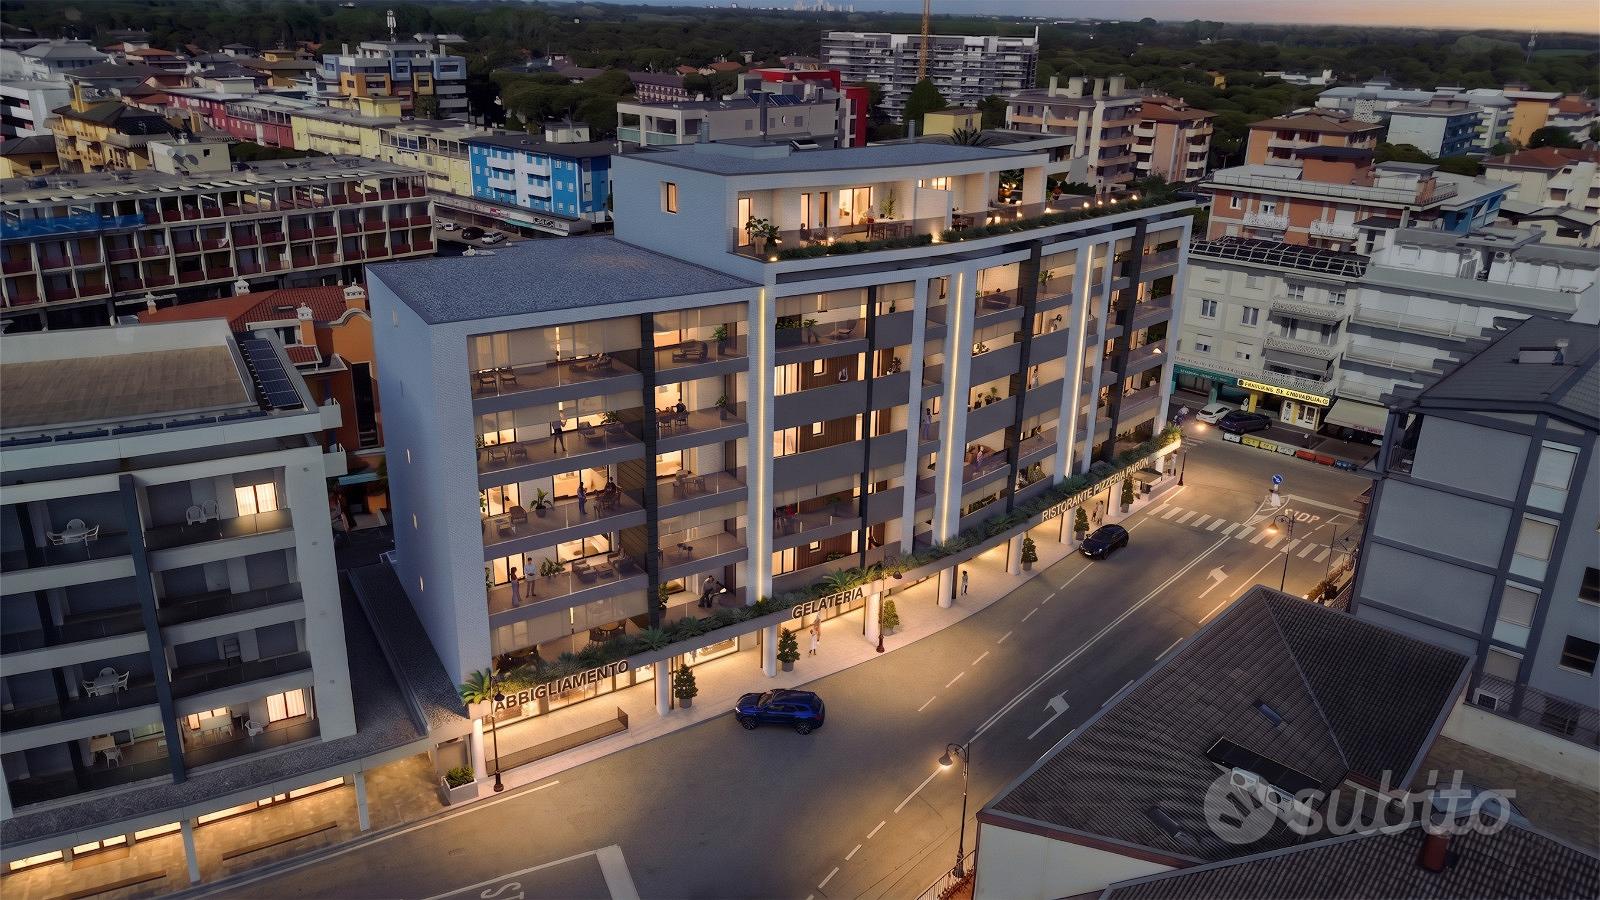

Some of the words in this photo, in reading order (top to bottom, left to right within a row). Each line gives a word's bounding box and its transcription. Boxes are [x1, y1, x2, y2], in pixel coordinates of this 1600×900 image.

[1042, 488, 1093, 521] RISTORANTE
[1093, 469, 1125, 496] PIZZERIA
[1125, 457, 1149, 477] PARON
[792, 587, 863, 619] GELATERIA
[494, 660, 629, 712] ABBIGLIAMENTO
